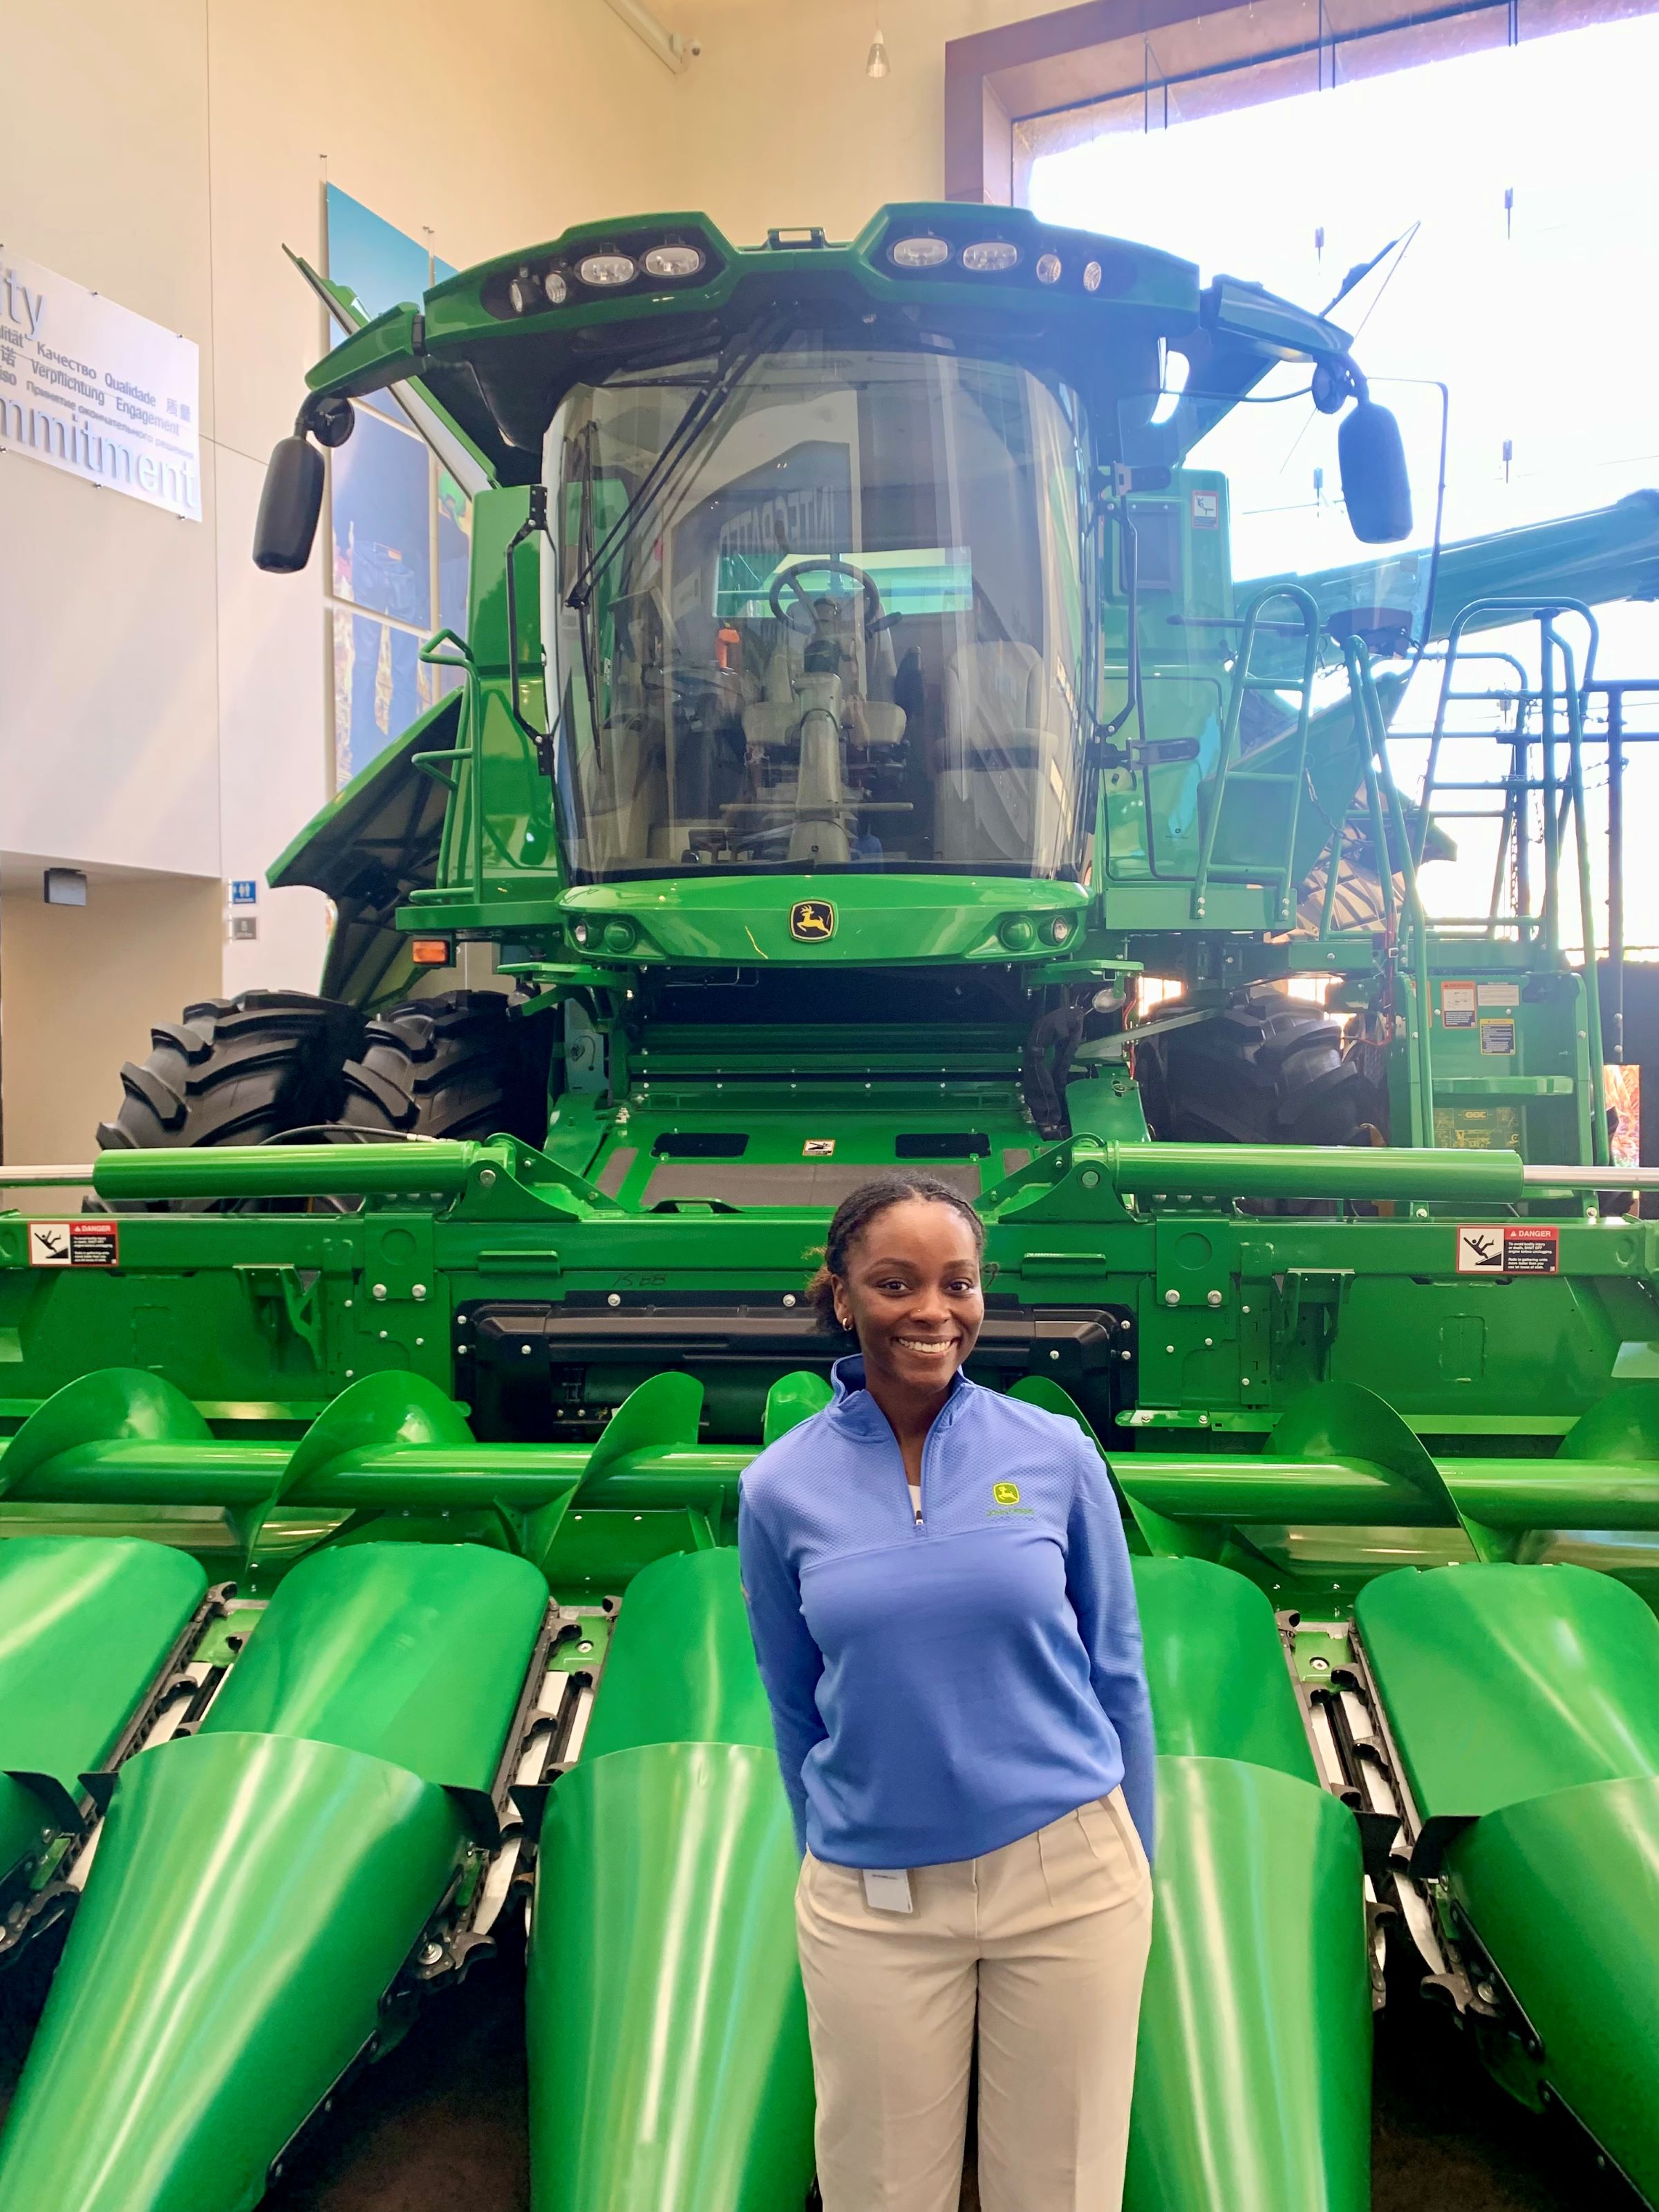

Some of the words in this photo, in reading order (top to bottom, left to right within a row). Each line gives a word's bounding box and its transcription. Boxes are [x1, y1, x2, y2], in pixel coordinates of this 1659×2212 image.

[31, 358, 104, 406] Verpflichtung
[116, 397, 180, 436] Engagement
[37, 341, 97, 379] Качество
[104, 373, 156, 407] Qualidade
